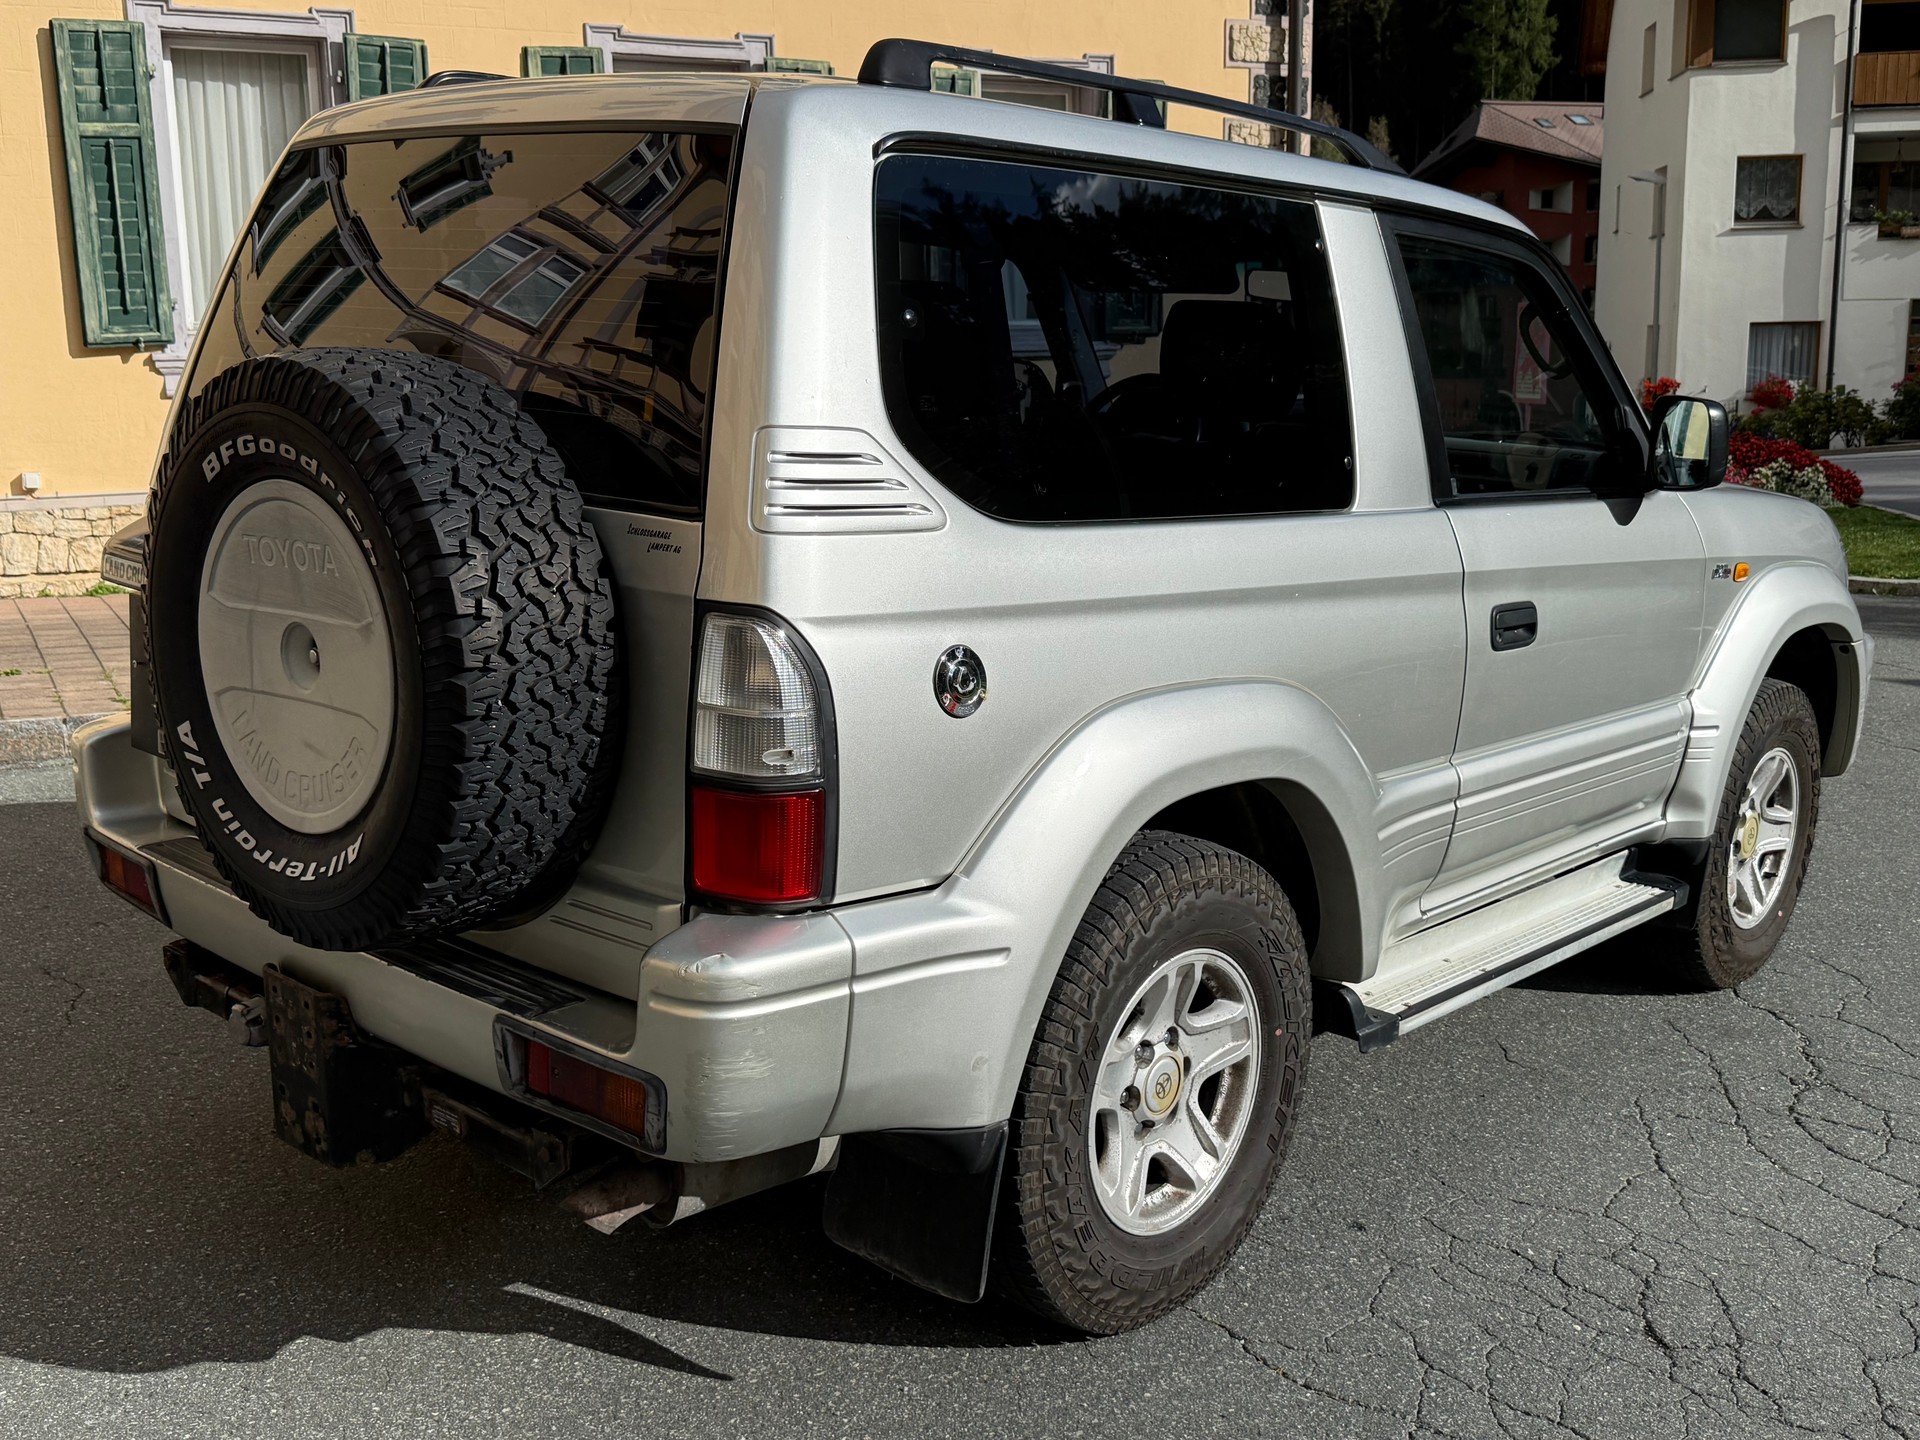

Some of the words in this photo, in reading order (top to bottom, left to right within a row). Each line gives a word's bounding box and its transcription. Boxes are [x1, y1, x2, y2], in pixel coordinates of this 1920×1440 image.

[202, 434, 377, 567] BFGoodrich
[105, 556, 125, 579] LAND
[242, 534, 340, 577] TOYOTA
[673, 545, 682, 554] AG
[177, 720, 212, 790] T/A
[232, 710, 280, 785] LAND
[284, 736, 368, 809] CRUISER
[212, 797, 364, 881] All-Terrain
